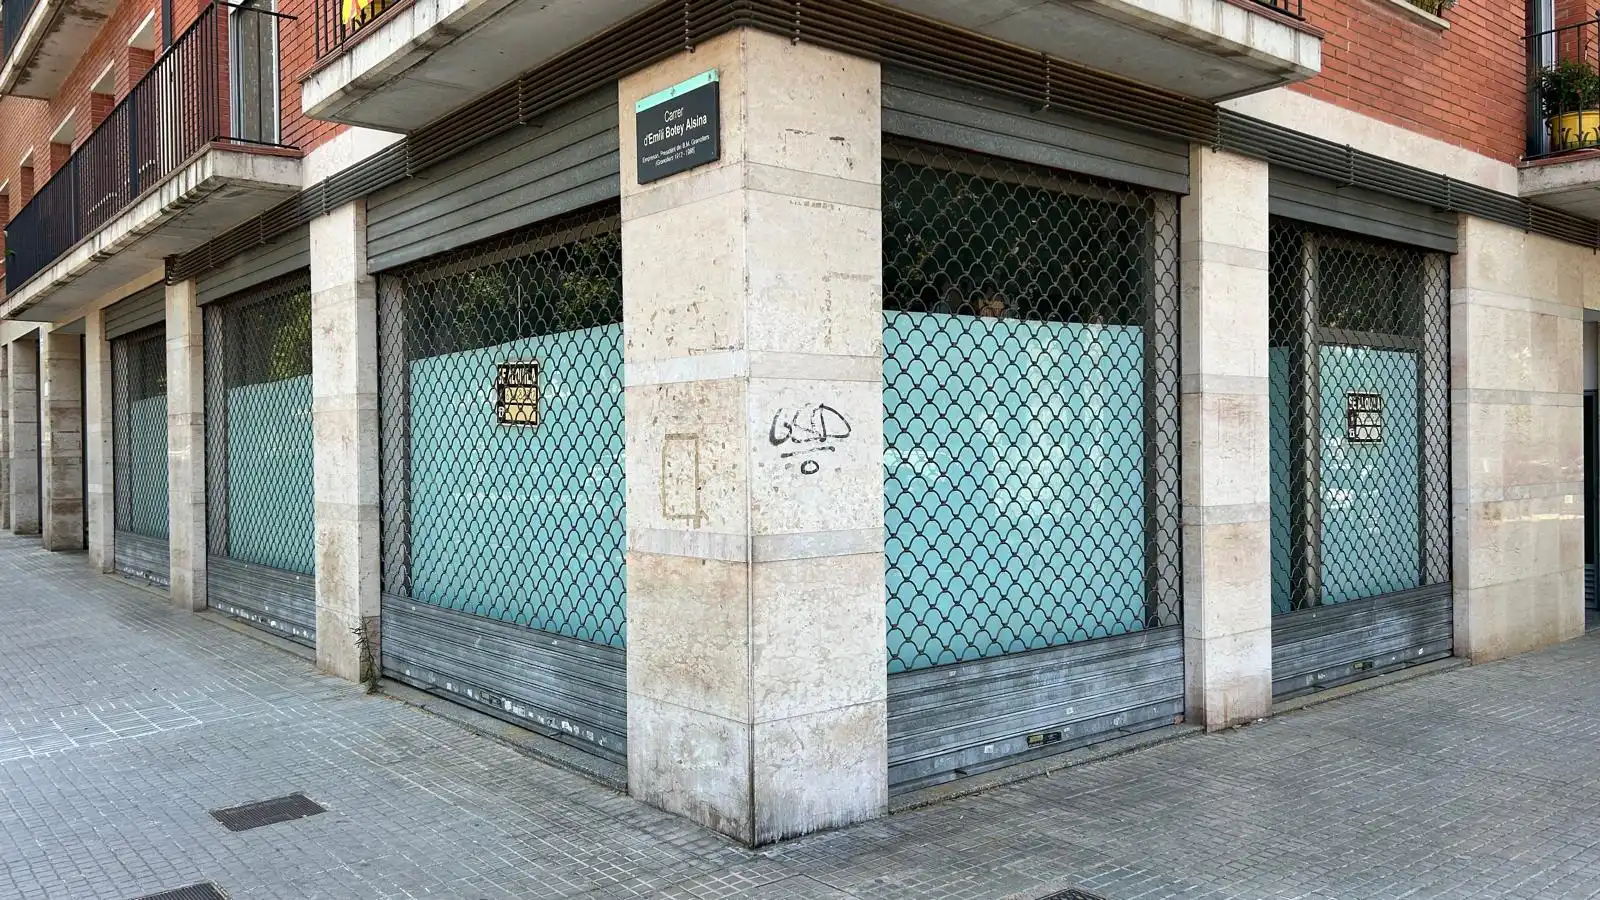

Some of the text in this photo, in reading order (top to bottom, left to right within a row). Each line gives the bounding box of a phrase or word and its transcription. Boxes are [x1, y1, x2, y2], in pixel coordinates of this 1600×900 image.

[664, 107, 684, 123] Carrer
[643, 114, 707, 147] d'Emili Botey Alsina
